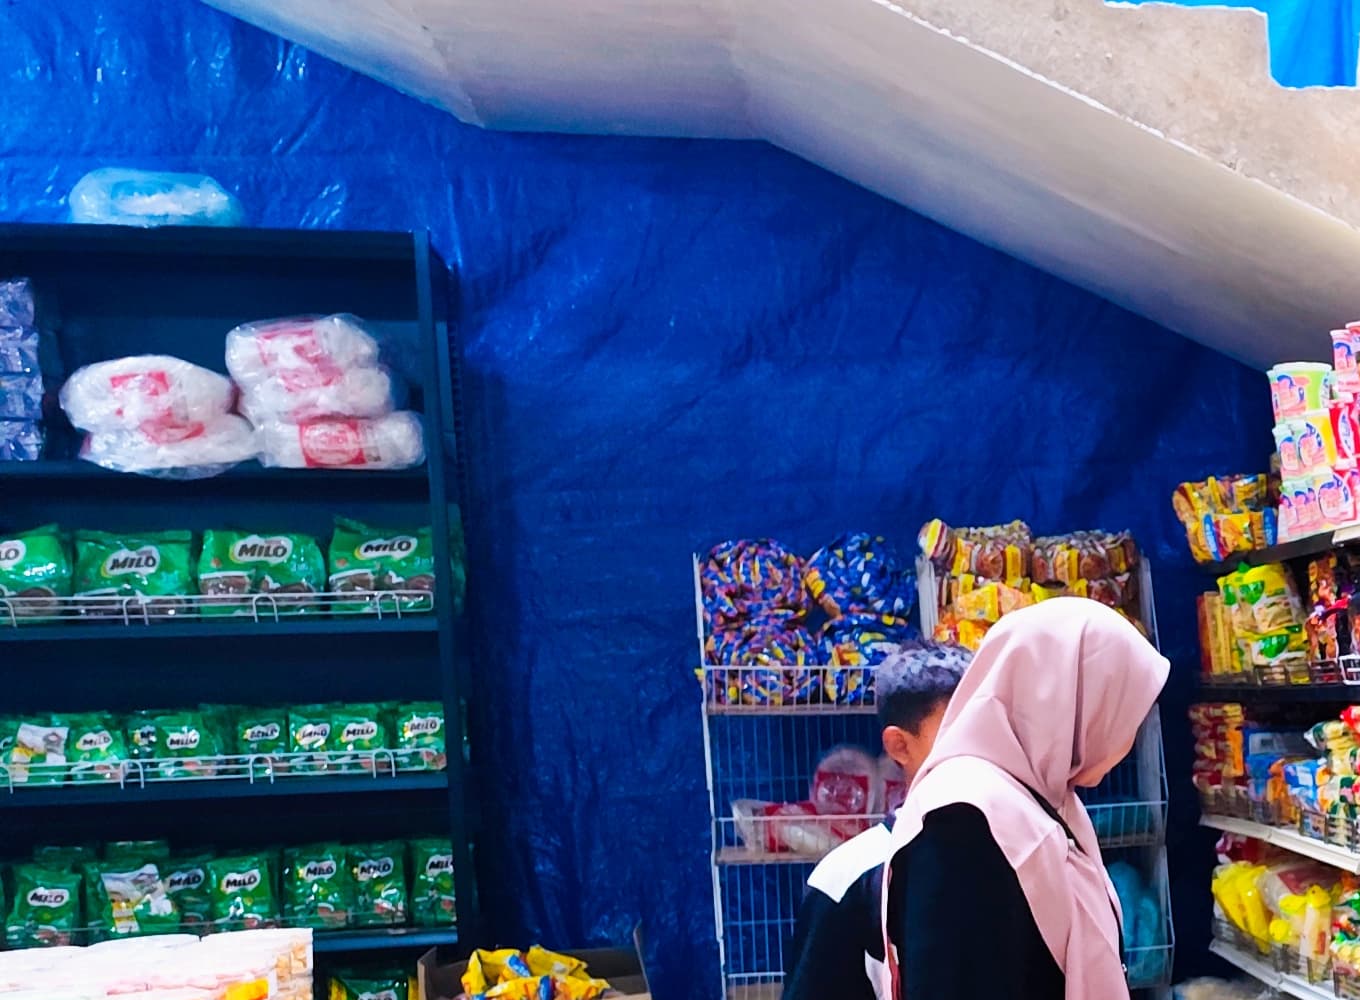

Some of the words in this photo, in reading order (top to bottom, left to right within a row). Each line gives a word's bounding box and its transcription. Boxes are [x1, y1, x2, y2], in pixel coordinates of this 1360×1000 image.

[237, 537, 288, 561] MILO
[362, 536, 412, 556] MILO
[109, 551, 157, 575] MILO
